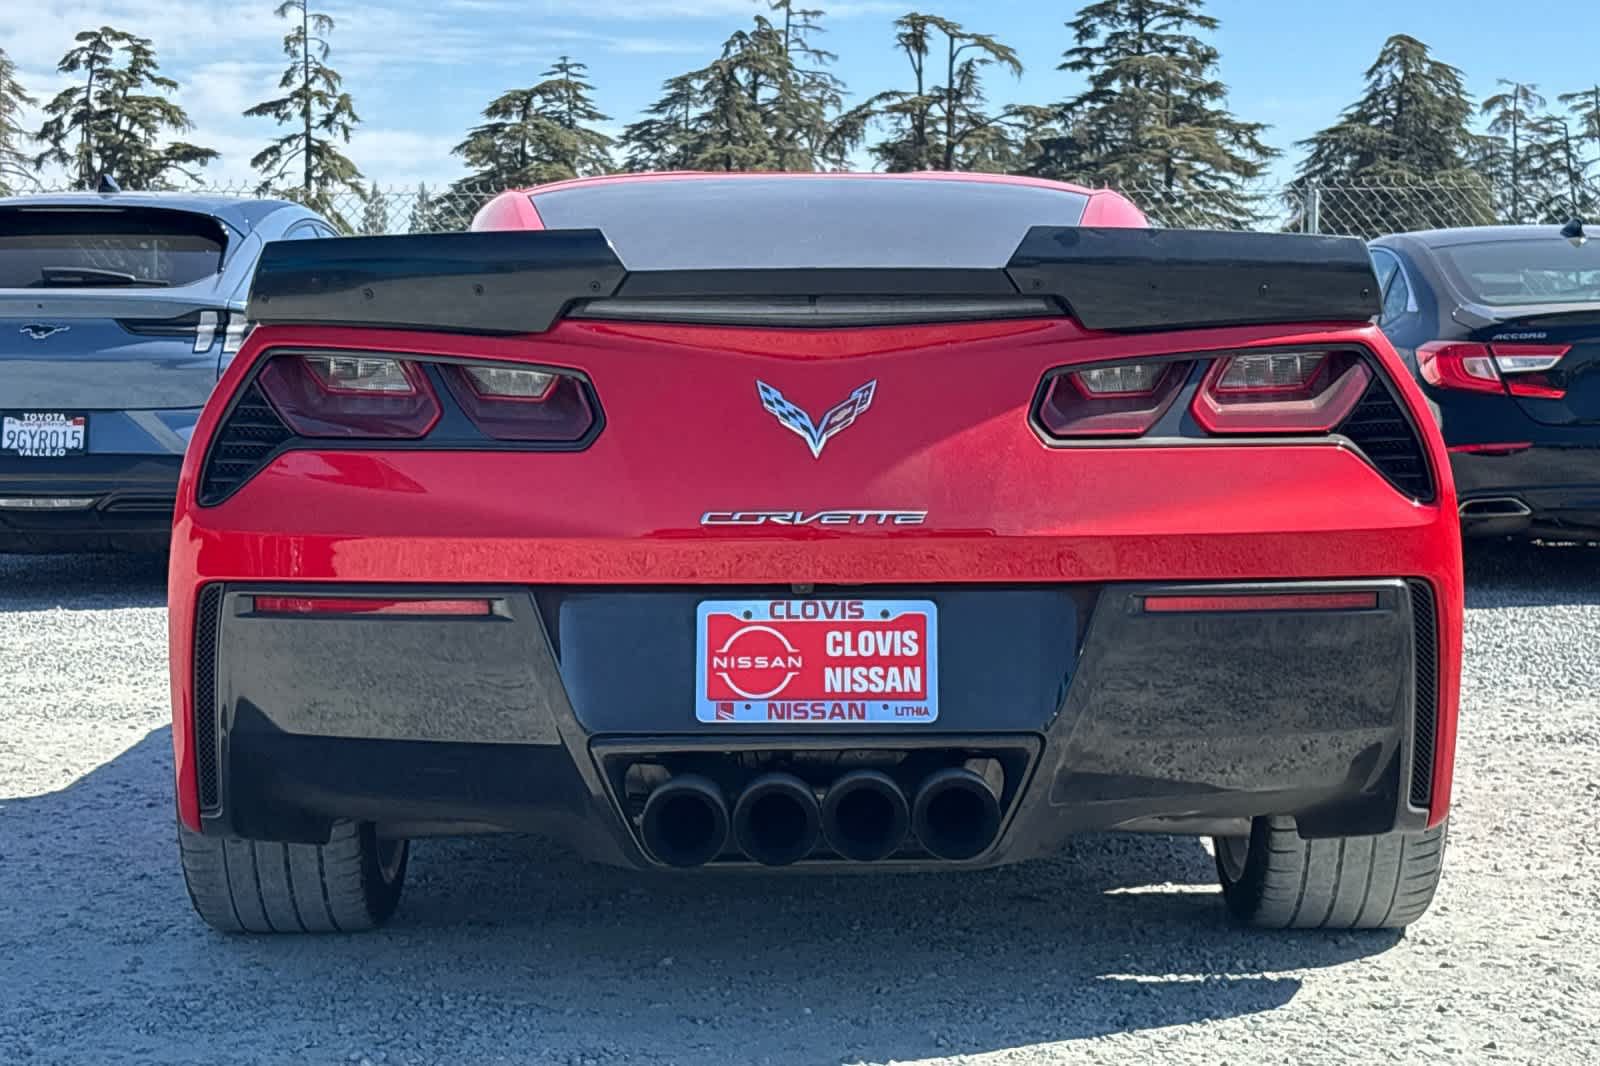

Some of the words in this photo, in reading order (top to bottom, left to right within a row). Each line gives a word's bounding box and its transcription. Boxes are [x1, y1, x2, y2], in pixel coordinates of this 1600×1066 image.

[1491, 332, 1547, 340] ACCORD
[24, 413, 66, 421] TOYOTA
[7, 430, 81, 449] 9GYR015
[701, 510, 928, 525] CORVETTE
[769, 601, 865, 620] CLOVIS
[826, 630, 919, 657] CLOVIS
[713, 656, 802, 669] NISSAN
[824, 666, 921, 693] NISSAN
[767, 703, 866, 720] NISSAN
[894, 706, 929, 716] LITHIA
